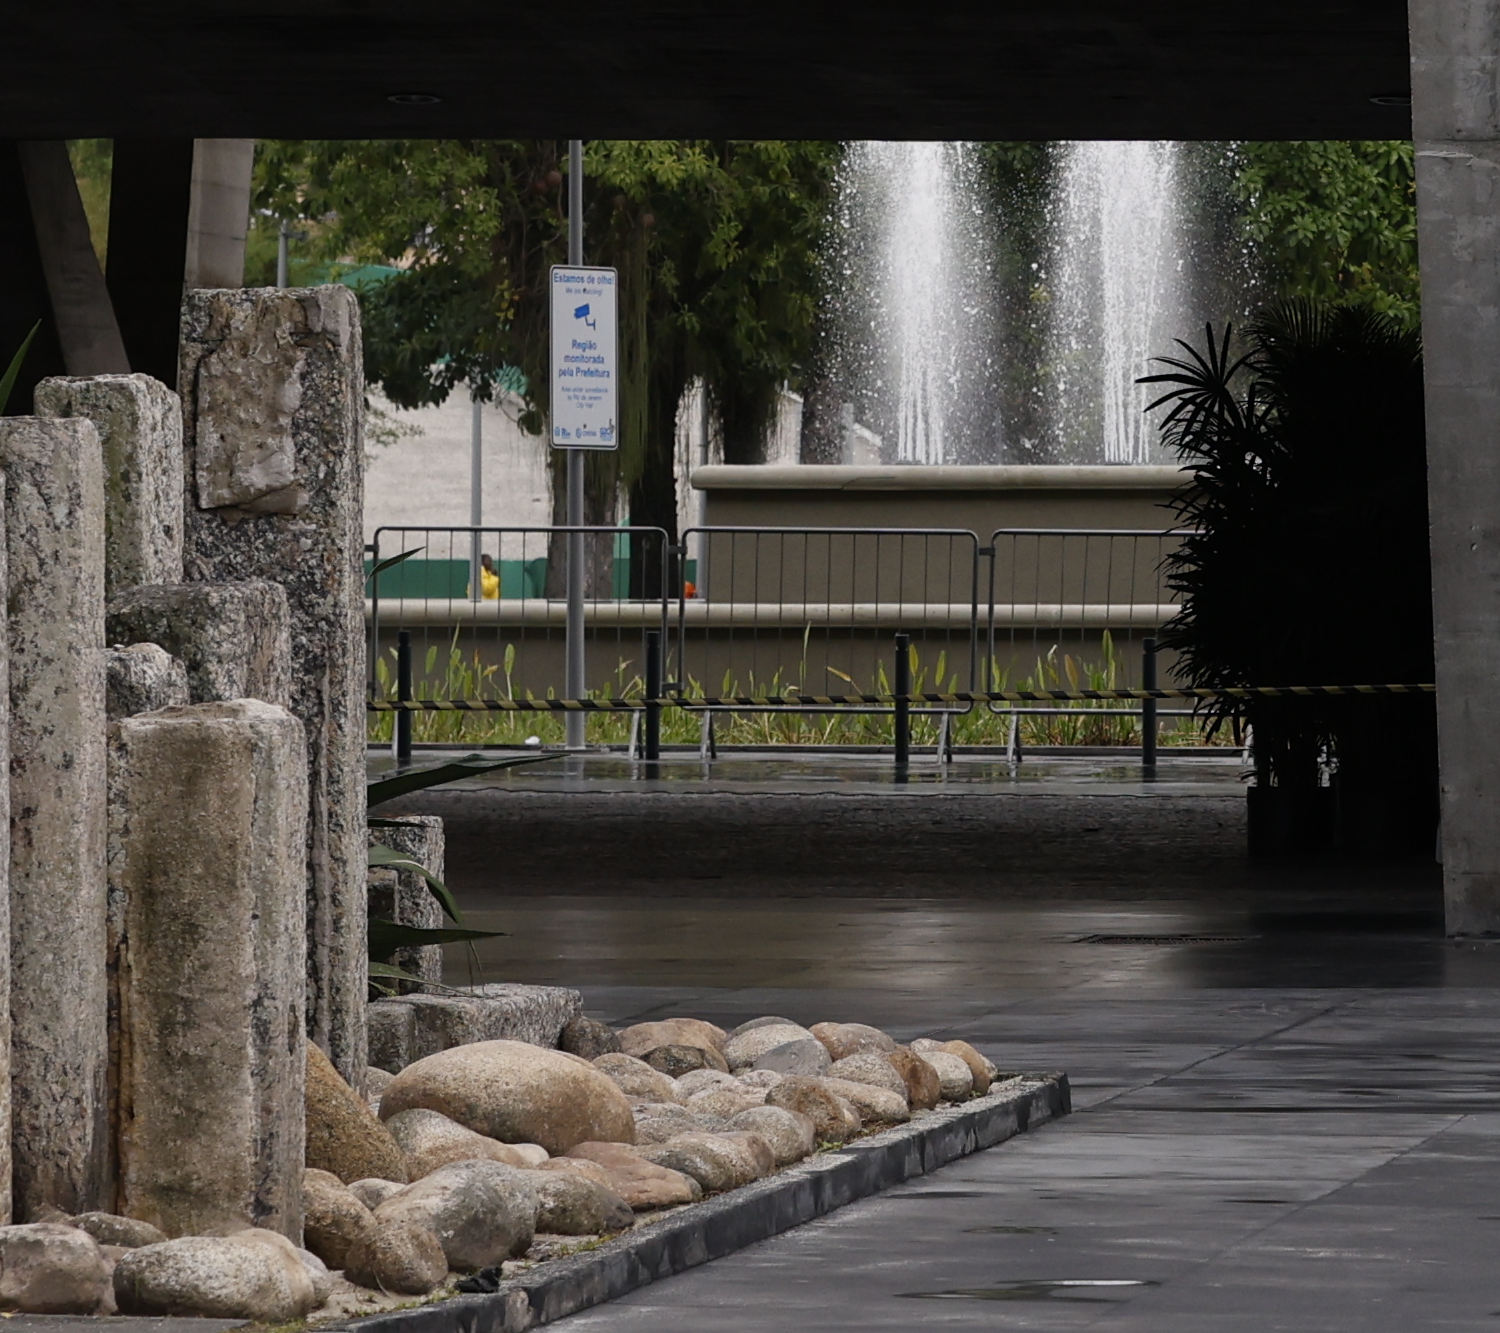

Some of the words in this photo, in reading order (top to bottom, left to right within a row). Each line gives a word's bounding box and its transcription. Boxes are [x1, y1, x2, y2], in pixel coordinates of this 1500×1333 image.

[554, 272, 585, 283] Estamos
[572, 339, 597, 353] Região
[564, 353, 605, 364] monitorada
[559, 366, 574, 379] pela
[575, 366, 610, 379] Prefeitura
